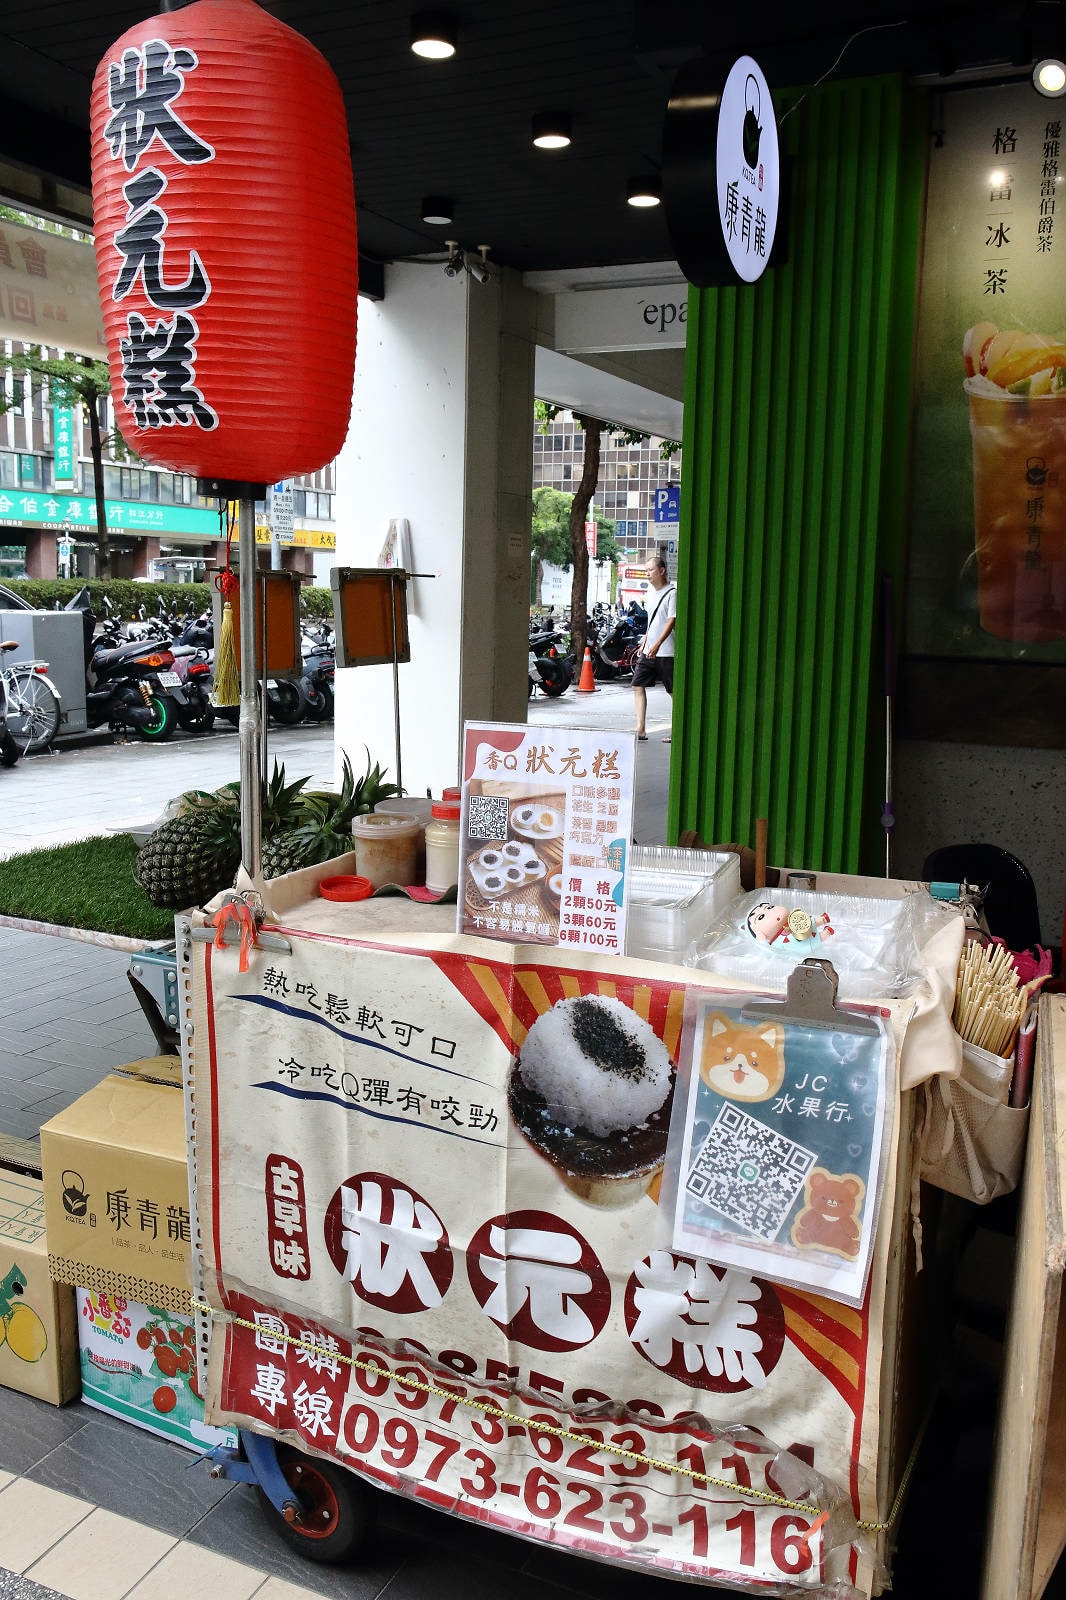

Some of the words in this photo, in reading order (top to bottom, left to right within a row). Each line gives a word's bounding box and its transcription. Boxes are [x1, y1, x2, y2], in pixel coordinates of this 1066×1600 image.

[724, 181, 767, 259] 康青龍
[1035, 120, 1063, 255] 優雅格雷伯爵茶
[103, 39, 219, 431] 狀元糕
[659, 490, 669, 509] P
[483, 750, 518, 772] 香Q
[525, 744, 622, 780] 狀元糕
[569, 831, 605, 846] 巧克力
[563, 913, 617, 931] 3顆60元
[564, 895, 618, 913] 2顆50元
[559, 929, 618, 948] 6顆100元
[263, 966, 457, 1060] 熱吃鬆軟可口
[277, 1056, 499, 1133] 冷吃Q彈有咬勁
[771, 1096, 849, 1124] 水果行
[795, 1073, 828, 1092] JC
[105, 1187, 191, 1243] 康青龍
[271, 1161, 308, 1278] 古早味
[340, 1180, 768, 1391] 狀元糕
[91, 1325, 124, 1345] TOMATO
[253, 1309, 343, 1383] 團購
[250, 1361, 336, 1438] 專線
[343, 1403, 815, 1576] 0973-623-116
